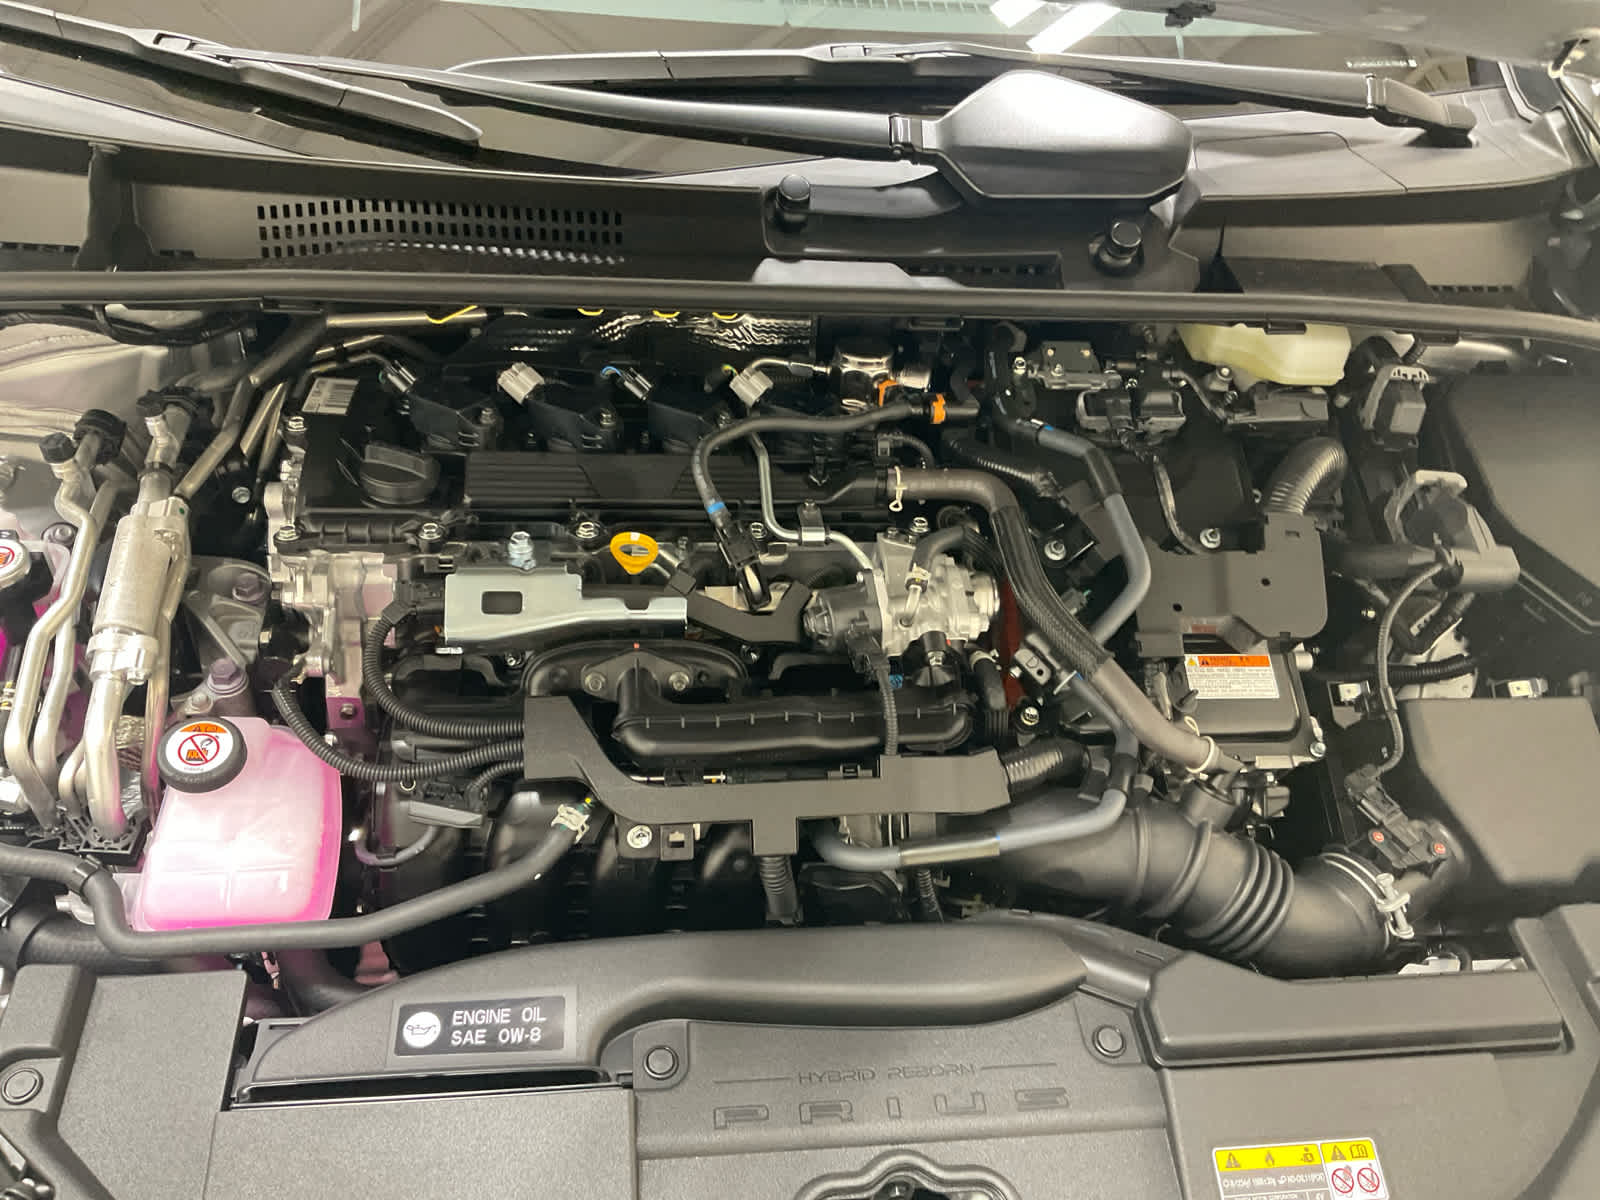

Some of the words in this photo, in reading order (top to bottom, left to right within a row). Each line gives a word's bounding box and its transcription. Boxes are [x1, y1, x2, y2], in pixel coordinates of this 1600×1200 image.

[451, 1008, 512, 1025] ENGINE
[521, 1007, 547, 1023] OIL
[450, 1029, 486, 1046] SAE
[498, 1027, 542, 1044] 0W-8
[799, 1068, 876, 1084] HYBRID
[887, 1063, 976, 1080] REBORN
[714, 1087, 1070, 1130] PRIUS
